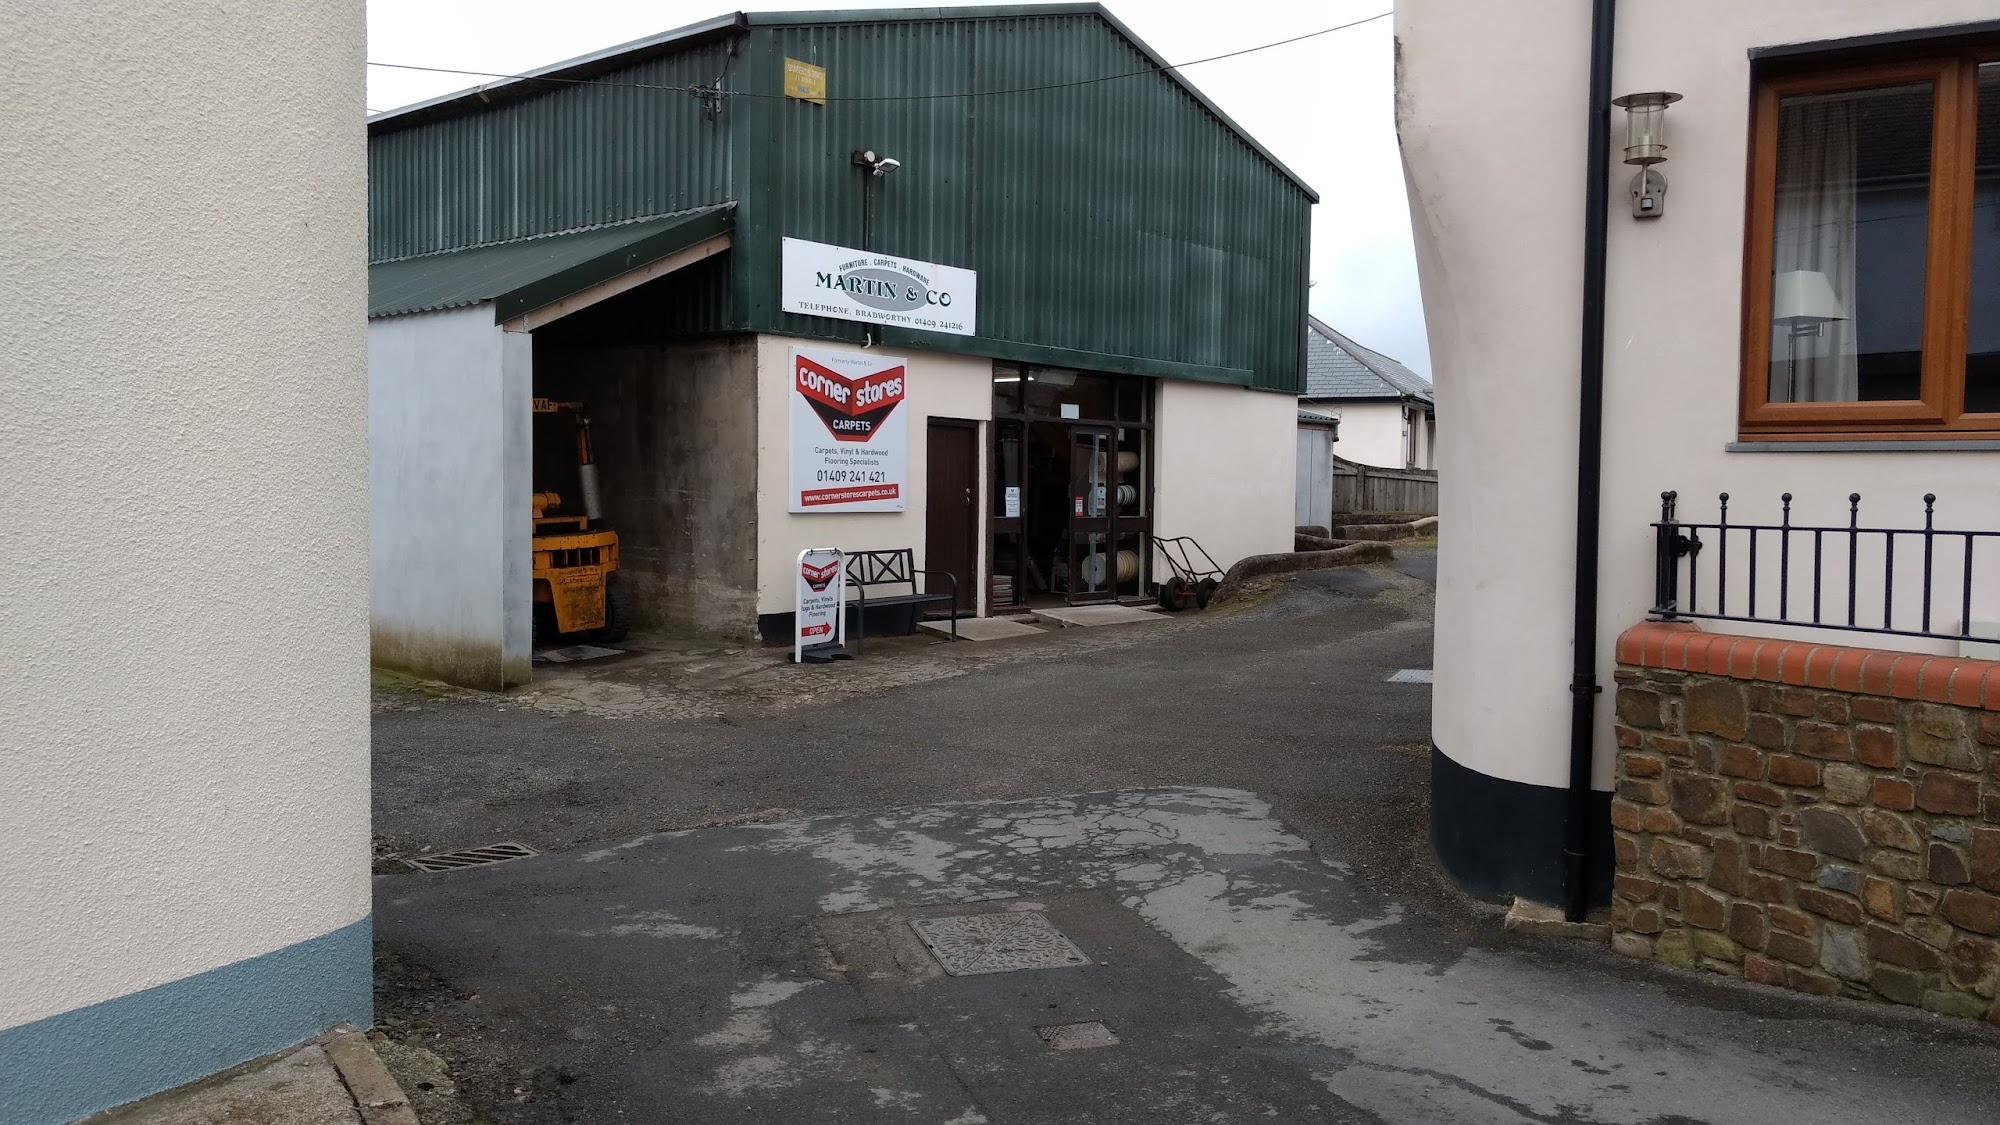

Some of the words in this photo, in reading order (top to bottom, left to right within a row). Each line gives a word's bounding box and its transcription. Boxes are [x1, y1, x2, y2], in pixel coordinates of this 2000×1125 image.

[839, 259, 868, 272] FURNITURE
[874, 258, 897, 269] CARPETS
[902, 265, 930, 285] HARDWARE
[816, 271, 898, 300] MARTIN
[906, 286, 918, 302] &
[926, 289, 952, 307] CO
[855, 310, 912, 323] BRADWORTHY
[914, 318, 936, 328] 01409
[940, 320, 963, 330] 241216
[800, 367, 851, 404] corner
[856, 378, 902, 407] stores
[833, 420, 870, 432] CARPETS
[815, 447, 838, 455] Carpets,
[825, 457, 848, 466] Flooring
[817, 470, 847, 481] 01409
[850, 471, 866, 482] 241
[869, 471, 885, 482] 421
[804, 487, 896, 502] www.cornerstorescarpets.co.uk
[803, 566, 820, 578] corner
[821, 565, 837, 578] stores
